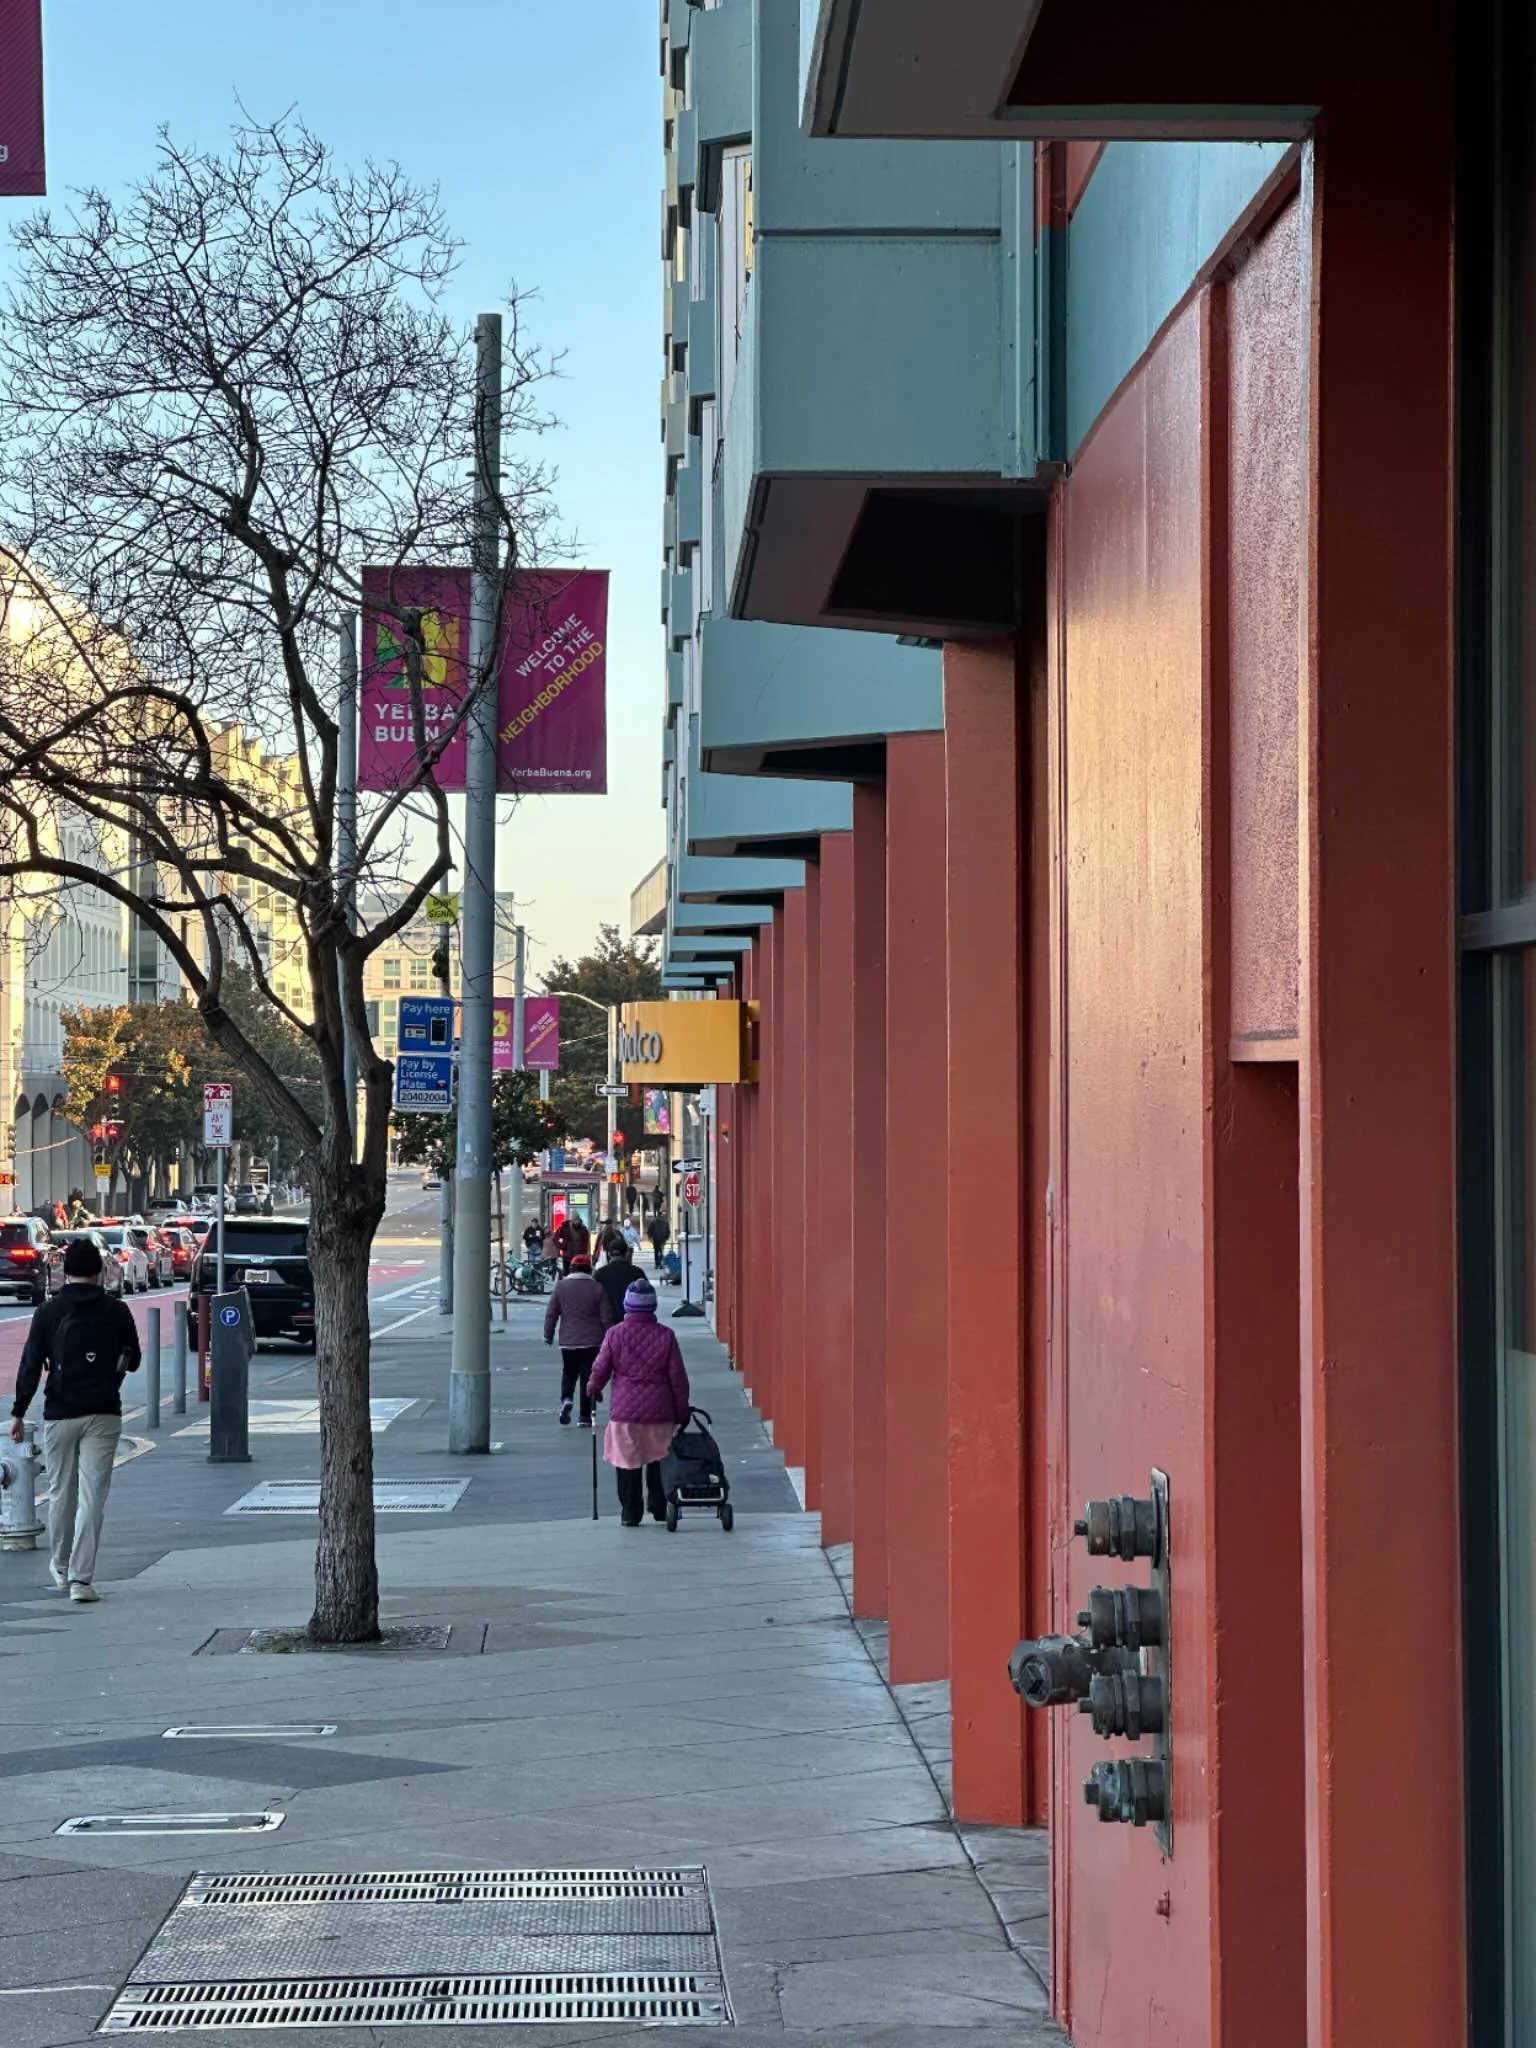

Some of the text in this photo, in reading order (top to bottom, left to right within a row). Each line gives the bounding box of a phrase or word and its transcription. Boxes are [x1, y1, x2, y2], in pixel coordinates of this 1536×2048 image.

[515, 613, 582, 677] WELCOME
[544, 626, 595, 674] TO THE
[499, 641, 603, 744] NEIGHBORHOOD
[375, 726, 457, 743] BUEN
[511, 767, 592, 780] YerbaBuena.org
[403, 1002, 451, 1016] Pay here
[400, 1058, 436, 1072] Pay by
[400, 1070, 439, 1080] License
[400, 1079, 427, 1089] Plate
